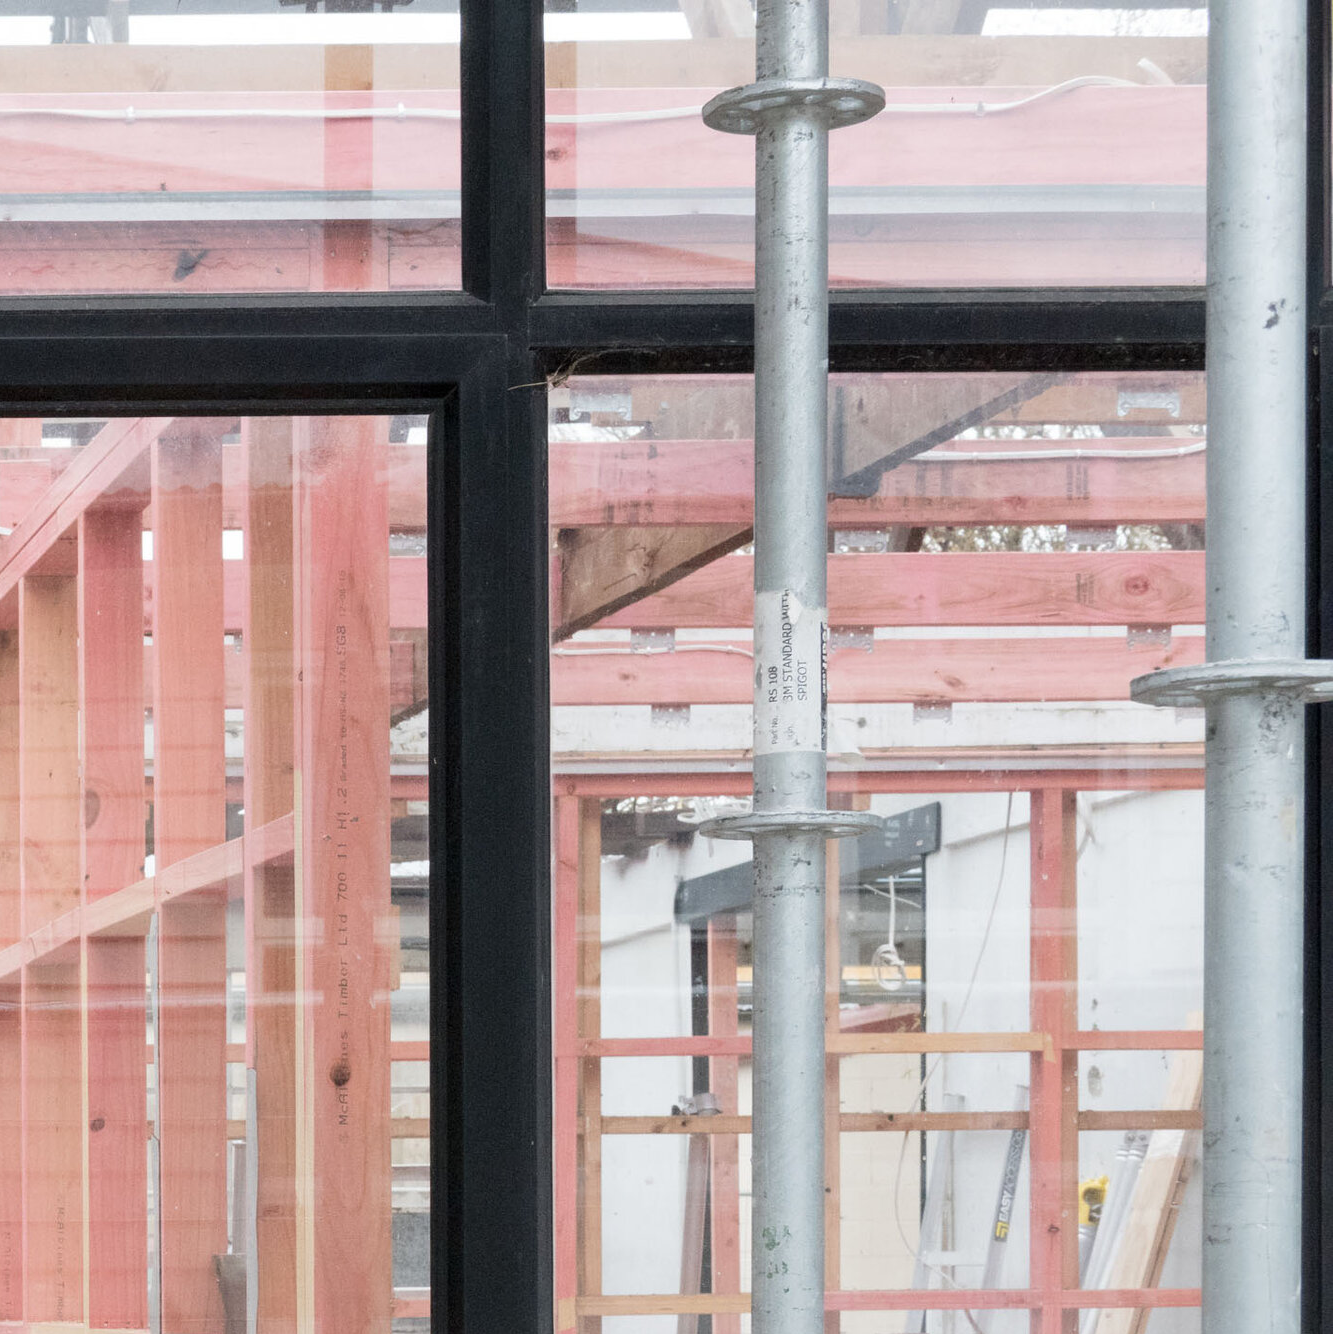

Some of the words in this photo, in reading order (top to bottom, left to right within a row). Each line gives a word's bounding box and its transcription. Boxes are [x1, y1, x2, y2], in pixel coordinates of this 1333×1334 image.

[335, 625, 347, 656] SG8
[781, 622, 792, 682] STANDARD
[768, 666, 778, 685] 108
[797, 659, 808, 701] SPIGOT
[768, 688, 778, 703] RS
[782, 685, 793, 702] 3M
[336, 871, 348, 902] 700
[337, 913, 348, 946] Ltd
[337, 959, 348, 1019] Timber
[337, 1030, 349, 1126] McAlines
